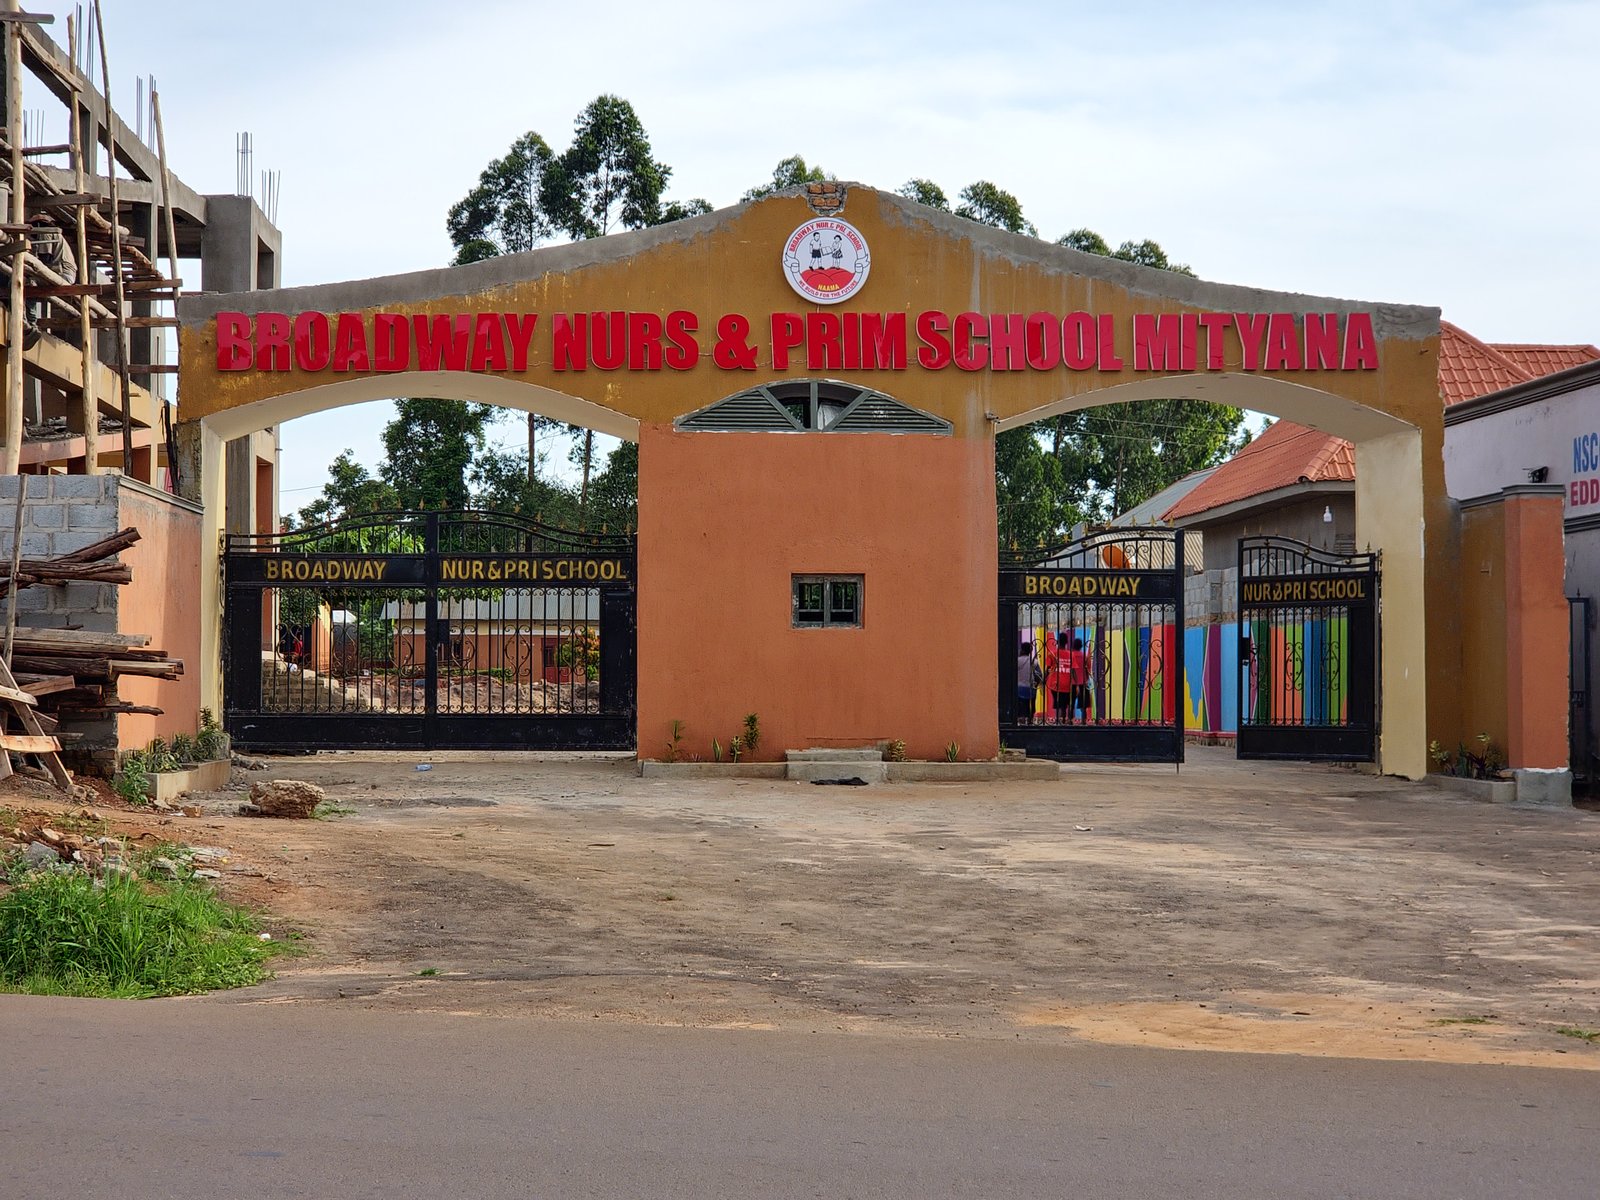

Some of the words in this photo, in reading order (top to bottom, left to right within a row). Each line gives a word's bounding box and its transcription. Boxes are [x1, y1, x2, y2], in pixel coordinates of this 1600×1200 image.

[789, 222, 815, 252] BROADWAY
[846, 231, 863, 251] SCHOOL
[805, 286, 819, 296] BUILD
[817, 284, 840, 292] NAAMA
[216, 310, 538, 373] BROADWAY
[552, 310, 700, 372] NURS
[713, 313, 758, 371] &
[771, 312, 908, 371] PRIM
[916, 311, 1124, 371] SCHOOL
[1133, 312, 1380, 371] MITYANA
[1573, 432, 1600, 474] NSC
[265, 559, 388, 582] BROADWAY
[1025, 575, 1142, 597] BROADWAY
[1309, 579, 1365, 600] SCHOOL
